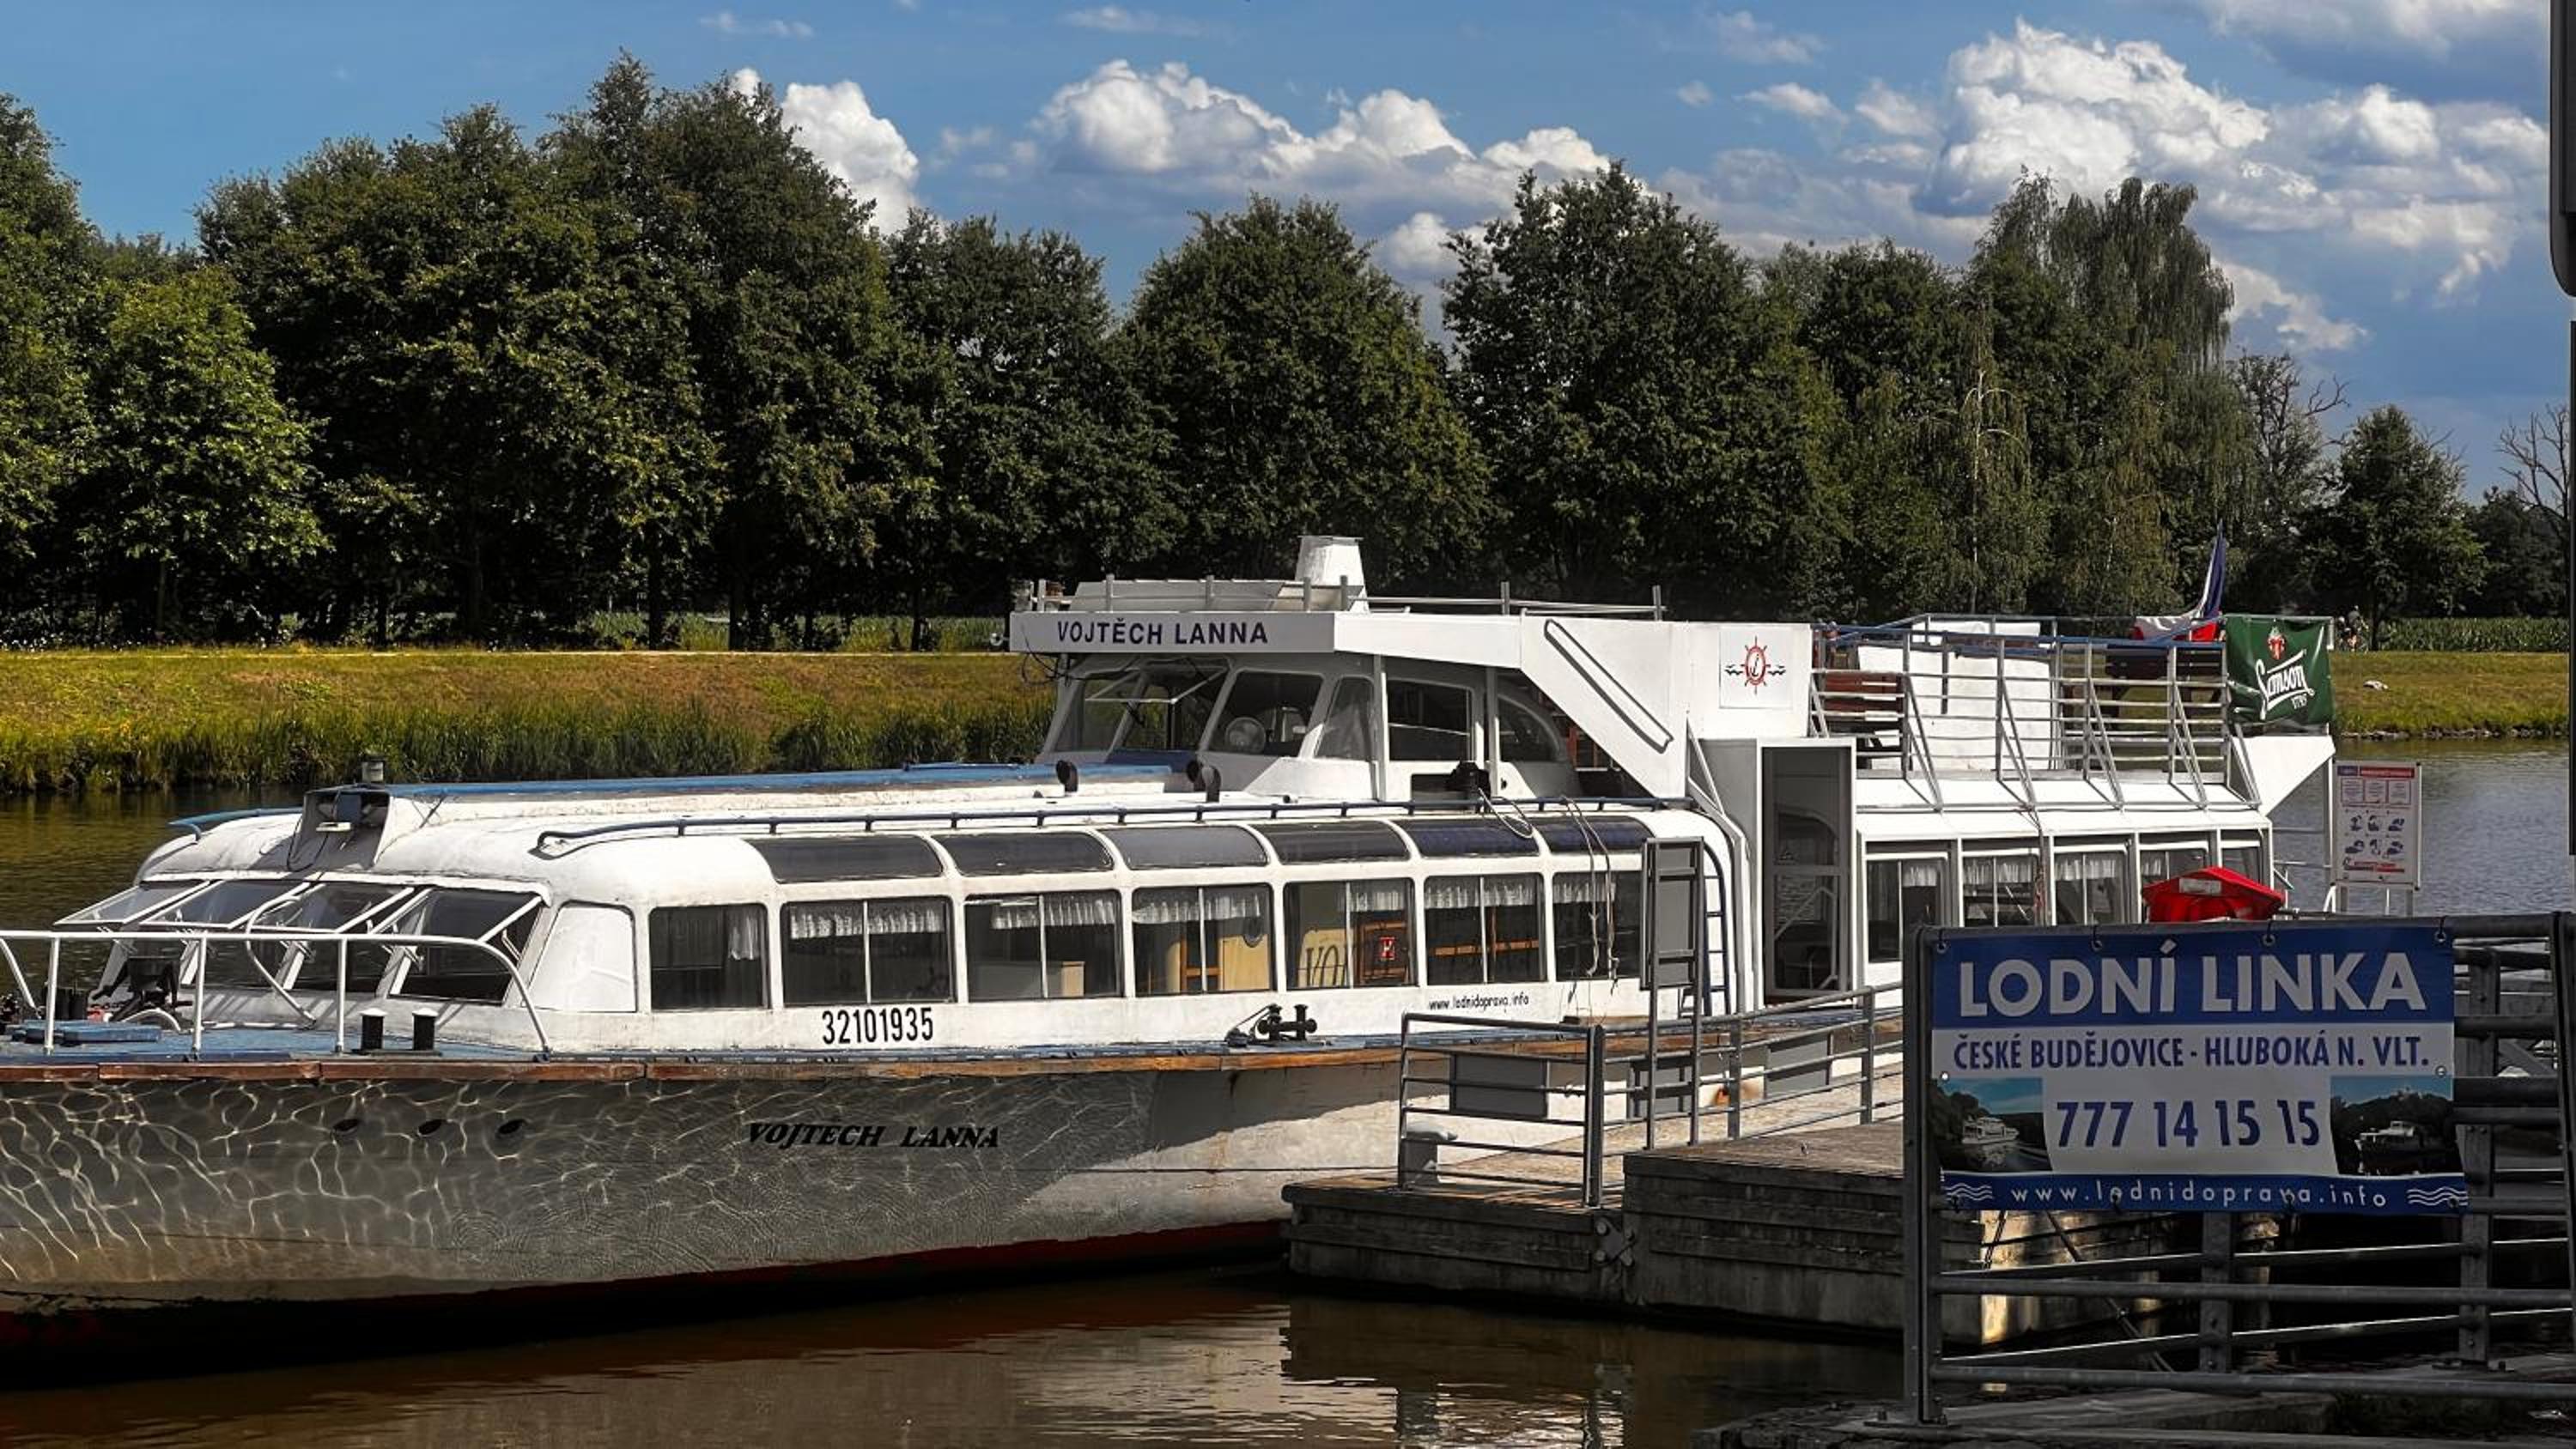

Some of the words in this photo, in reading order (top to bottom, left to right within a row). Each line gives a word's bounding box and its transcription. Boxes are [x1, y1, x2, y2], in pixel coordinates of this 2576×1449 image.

[1058, 618, 1163, 645] VOJTĚCH
[1175, 622, 1268, 645] LANNA
[1960, 939, 2176, 1017] LODNÍ
[2202, 952, 2427, 1012] LINKA
[822, 1007, 933, 1045] 32101935
[1953, 1034, 2022, 1069] ČESKÉ
[2031, 1031, 2184, 1068] BUDĚJOVICE
[2205, 1030, 2330, 1067] HLUBOKÁ
[2338, 1037, 2365, 1066] N.
[2372, 1036, 2429, 1066] VLT.
[900, 1126, 999, 1148] LANNA
[2057, 1101, 2134, 1148] 777
[2154, 1100, 2199, 1148] 14
[2215, 1100, 2261, 1146] 15
[2276, 1100, 2320, 1146] 15
[2010, 1179, 2387, 1209] www.lodnidoprava.info
